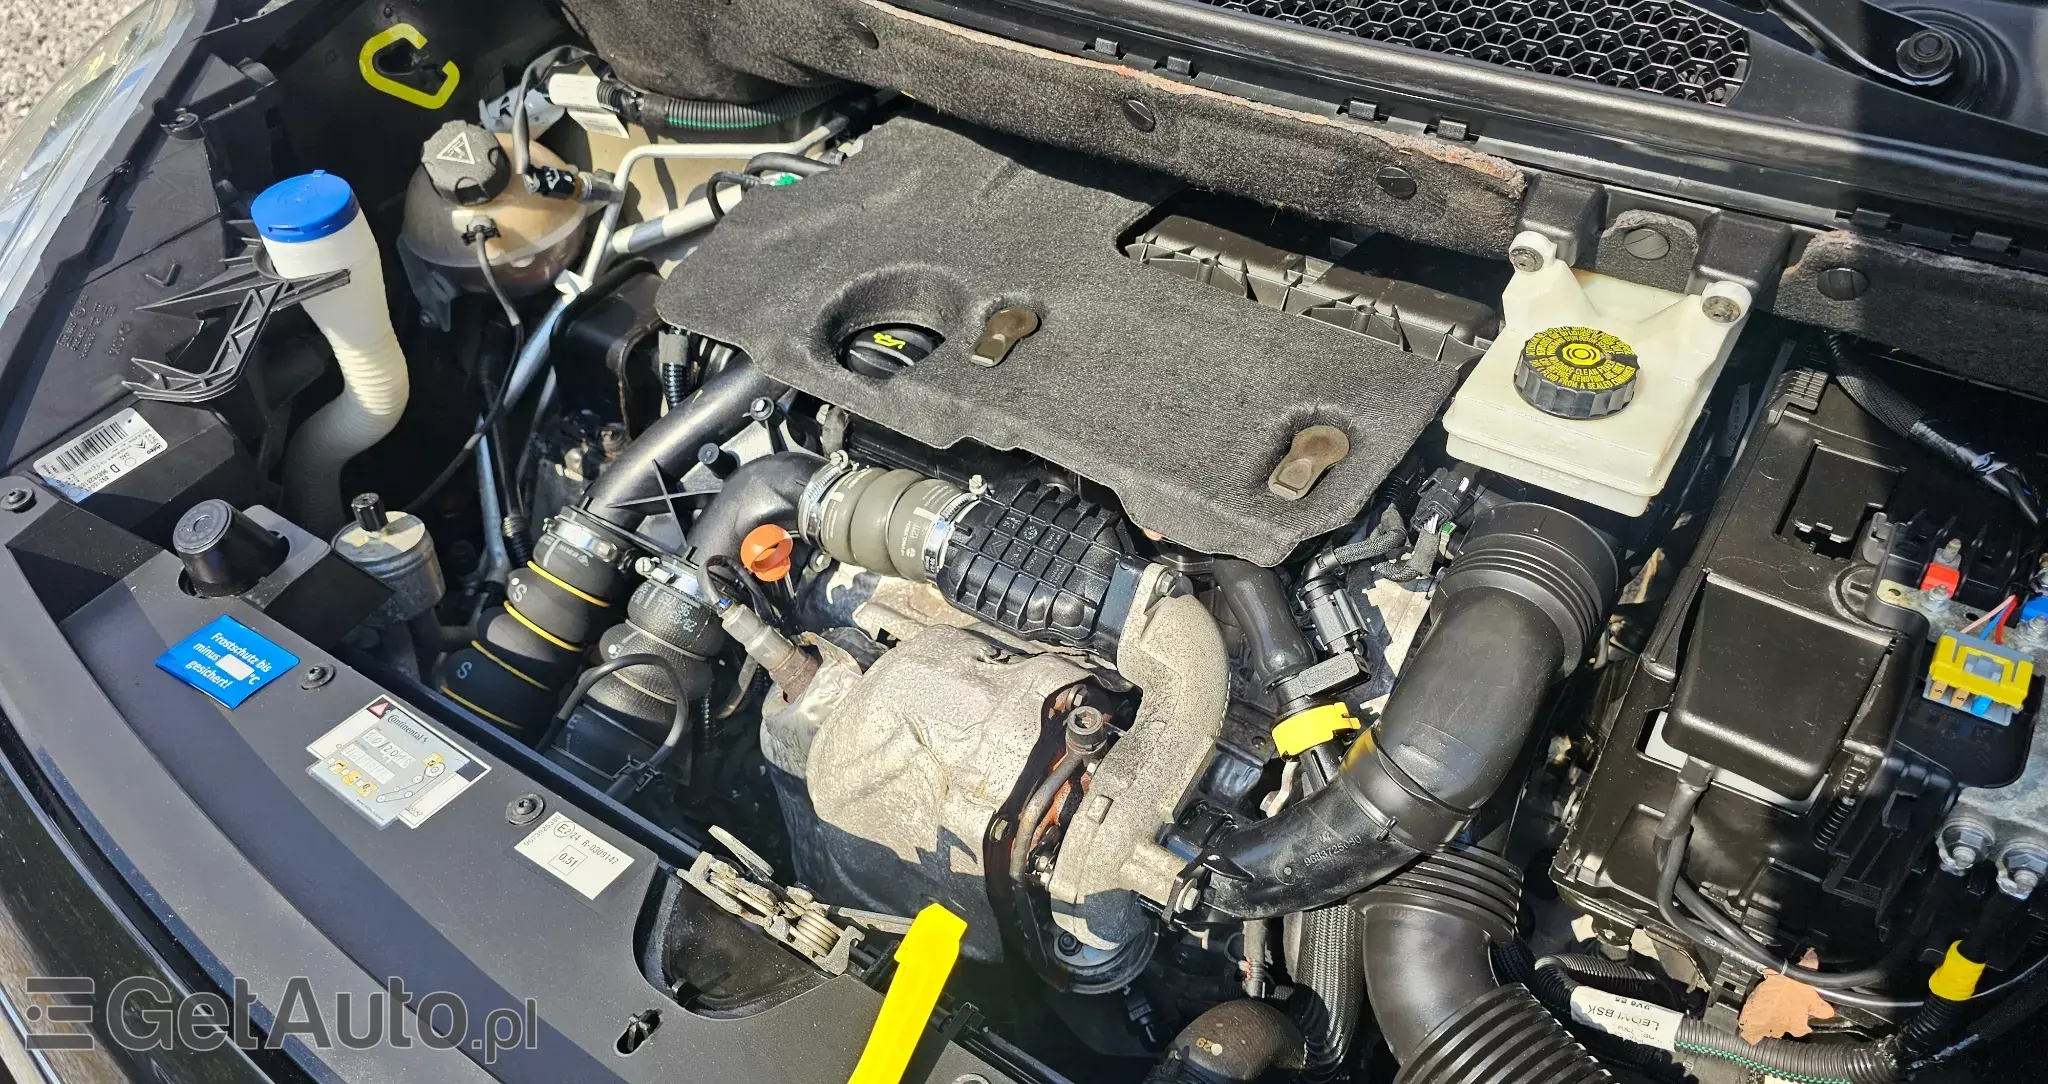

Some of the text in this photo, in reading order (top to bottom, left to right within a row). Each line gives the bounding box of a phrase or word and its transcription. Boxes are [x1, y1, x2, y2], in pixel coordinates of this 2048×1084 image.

[1557, 378, 1577, 388] FROM
[1588, 381, 1613, 390] SEALED
[109, 464, 120, 474] D
[512, 583, 528, 602] S
[193, 643, 221, 662] minus
[210, 632, 272, 673] Frostschutz bis
[185, 660, 233, 689] gesichert!
[456, 661, 473, 679] S
[387, 714, 422, 743] Continental
[1588, 1004, 1615, 1018] BSK
